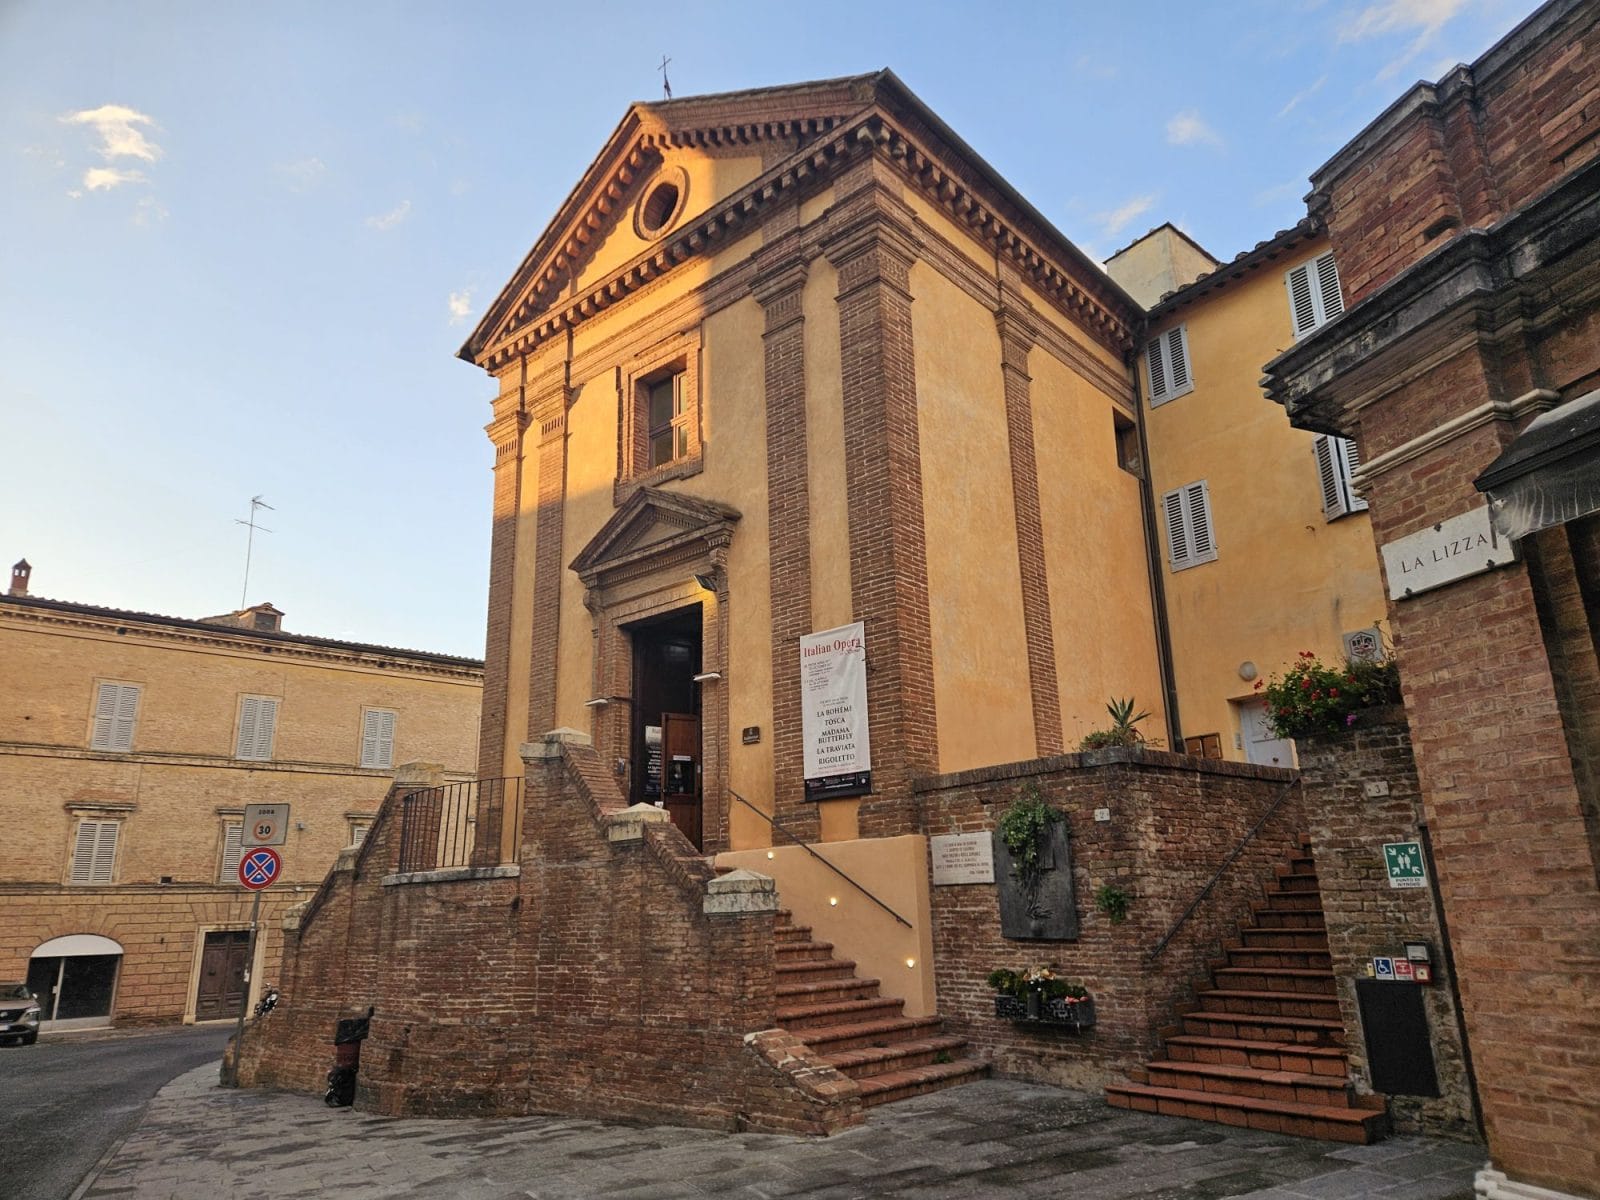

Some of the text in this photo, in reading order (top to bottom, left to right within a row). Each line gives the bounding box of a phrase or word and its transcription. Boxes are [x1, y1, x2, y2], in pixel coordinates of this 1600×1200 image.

[1401, 533, 1488, 573] LA LIZZA
[804, 644, 831, 658] Italian
[833, 637, 861, 651] Opera
[824, 717, 846, 726] TOSCA
[821, 726, 850, 737] MADAMA
[818, 732, 853, 744] BUTTERFLY
[825, 743, 856, 753] TRAVIATA
[818, 753, 856, 765] RIGOLETTO
[258, 824, 271, 835] 30
